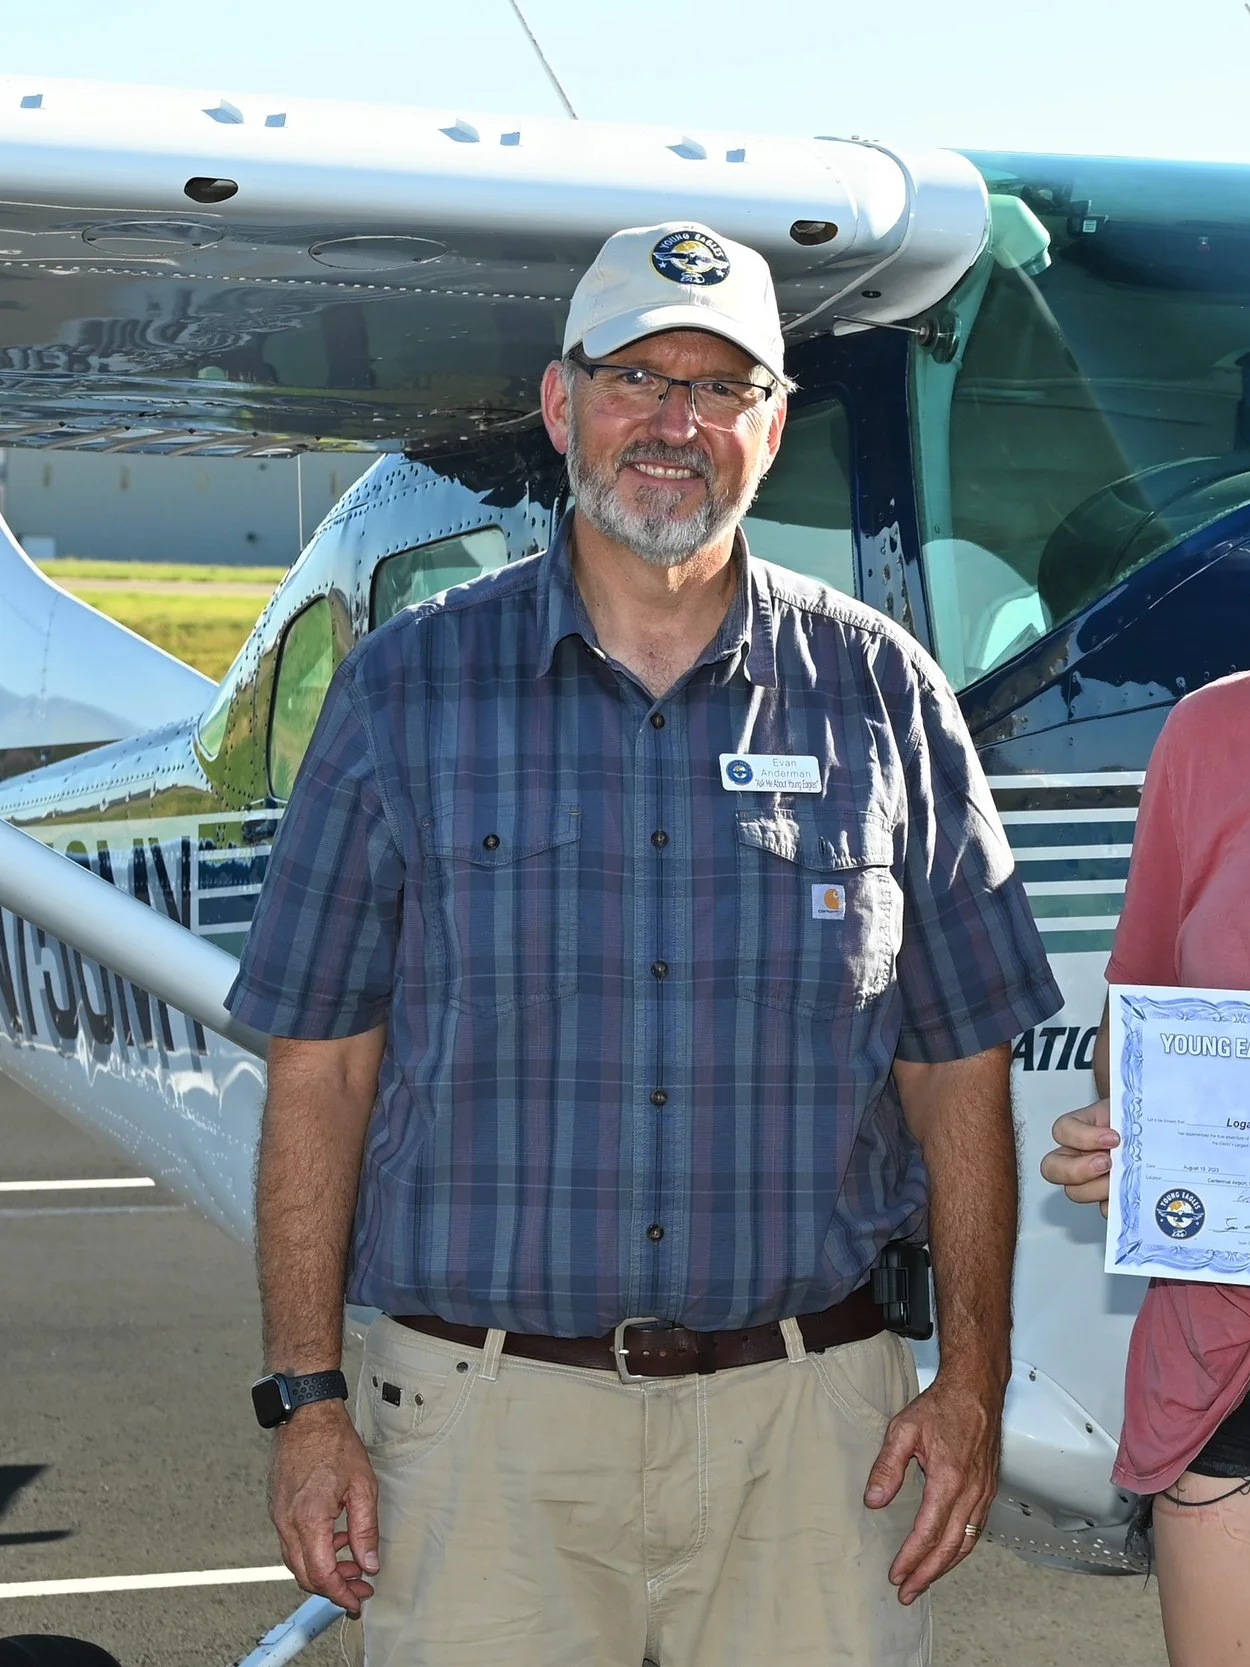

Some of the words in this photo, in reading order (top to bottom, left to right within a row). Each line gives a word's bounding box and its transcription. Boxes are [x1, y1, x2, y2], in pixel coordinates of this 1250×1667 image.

[659, 233, 690, 249] YOUNG
[695, 233, 724, 257] EAGLES
[772, 758, 797, 767] Evan
[760, 769, 812, 778] Anderman
[1159, 1033, 1231, 1058] YOUNG
[1160, 1191, 1180, 1206] YOUNG
[1182, 1191, 1201, 1209] EAGLES
